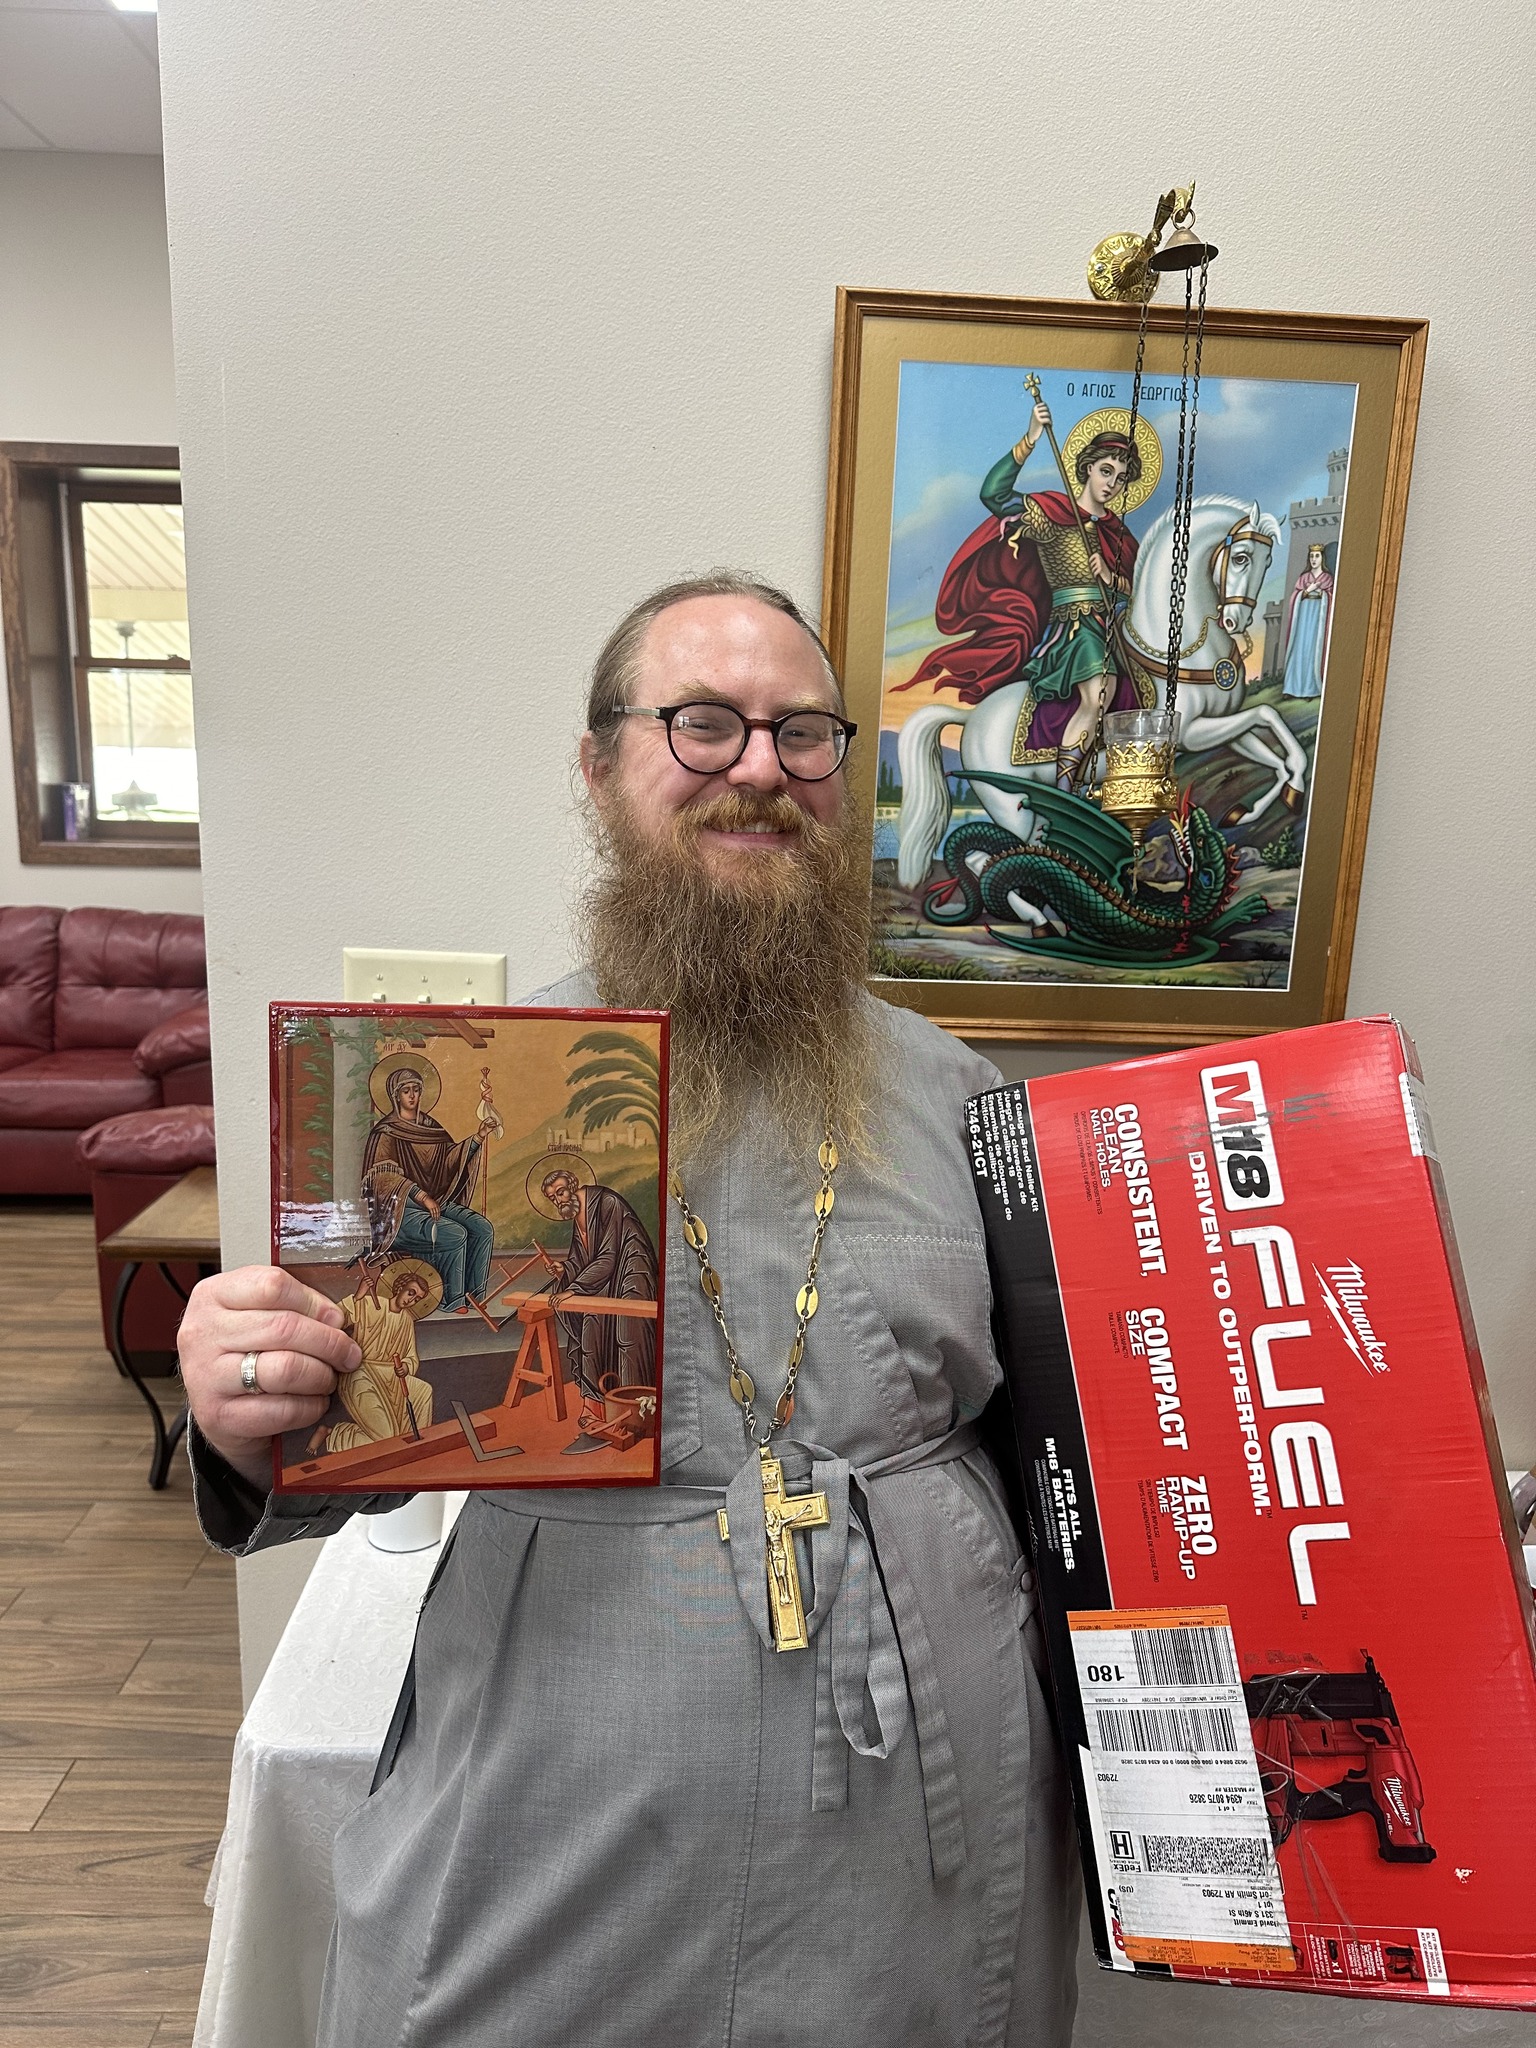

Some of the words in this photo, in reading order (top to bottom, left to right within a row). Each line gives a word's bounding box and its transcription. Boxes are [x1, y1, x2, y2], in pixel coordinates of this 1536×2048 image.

[1082, 383, 1116, 398] ΑΓΙΟΣ
[1004, 1091, 1012, 1121] Juego
[1014, 1089, 1020, 1100] 18
[980, 1095, 991, 1128] finition
[987, 1094, 999, 1141] Ensemble
[1015, 1103, 1025, 1135] Gauge
[1089, 1109, 1104, 1139] NAIL
[968, 1100, 988, 1178] 2746-21CT
[986, 1131, 993, 1143] de
[996, 1092, 1006, 1126] puntas
[1002, 1129, 1013, 1163] calibre
[1008, 1165, 1015, 1177] 18
[1009, 1124, 1016, 1136] de
[1100, 1107, 1123, 1174] CLEAN
[1211, 1071, 1271, 1199] M18
[988, 1146, 999, 1180] calibre
[994, 1144, 1002, 1156] de
[1011, 1139, 1024, 1188] clavadora
[1021, 1138, 1030, 1163] Brad
[1025, 1165, 1034, 1195] Nailer
[1094, 1143, 1110, 1188] HOLES
[994, 1183, 1001, 1194] 18
[997, 1160, 1009, 1205] cloueuse
[1114, 1104, 1166, 1277] CONSISTENT,
[1020, 1192, 1027, 1204] de
[1031, 1198, 1040, 1212] Kit
[1188, 1151, 1223, 1254] DRIVEN
[1005, 1208, 1012, 1220] de
[1209, 1261, 1231, 1300] TO
[1326, 1257, 1391, 1374] Milwaukee
[1111, 1328, 1119, 1353] COMPACTE
[1120, 1332, 1128, 1358] COMPACTO
[1125, 1310, 1146, 1356] SIZE
[1139, 1307, 1189, 1452] COMPACT
[1217, 1308, 1271, 1516] OUTPERFORM.
[1229, 1225, 1351, 1606] FUEL
[1062, 1468, 1076, 1505] FITS
[1147, 1489, 1155, 1507] TIEMPO
[1155, 1478, 1170, 1513] TIME
[1068, 1509, 1082, 1540] ALL
[1137, 1480, 1145, 1497] TEMPS
[1149, 1549, 1157, 1568] VITESSE
[1165, 1476, 1196, 1580] RAMP-UP
[1180, 1476, 1217, 1556] ZERO
[1087, 1665, 1124, 1682] 180
[1097, 1773, 1118, 1781] 72903
[1189, 1794, 1206, 1803] 3826
[1207, 1794, 1224, 1803] 8075
[1226, 1794, 1242, 1803] 4394
[1386, 1776, 1412, 1826] Milwaukee
[1112, 1834, 1129, 1855] H
[1113, 1864, 1141, 1872] FedEx
[1119, 1885, 1134, 1893] (US)
[1202, 1889, 1223, 1898] 72903
[1225, 1890, 1234, 1898] AR
[1237, 1891, 1257, 1899] Smith
[1332, 1962, 1343, 1973] x1
[1430, 1952, 1438, 1977] INCLUYE
[1434, 1944, 1442, 1973] INCLUDES
